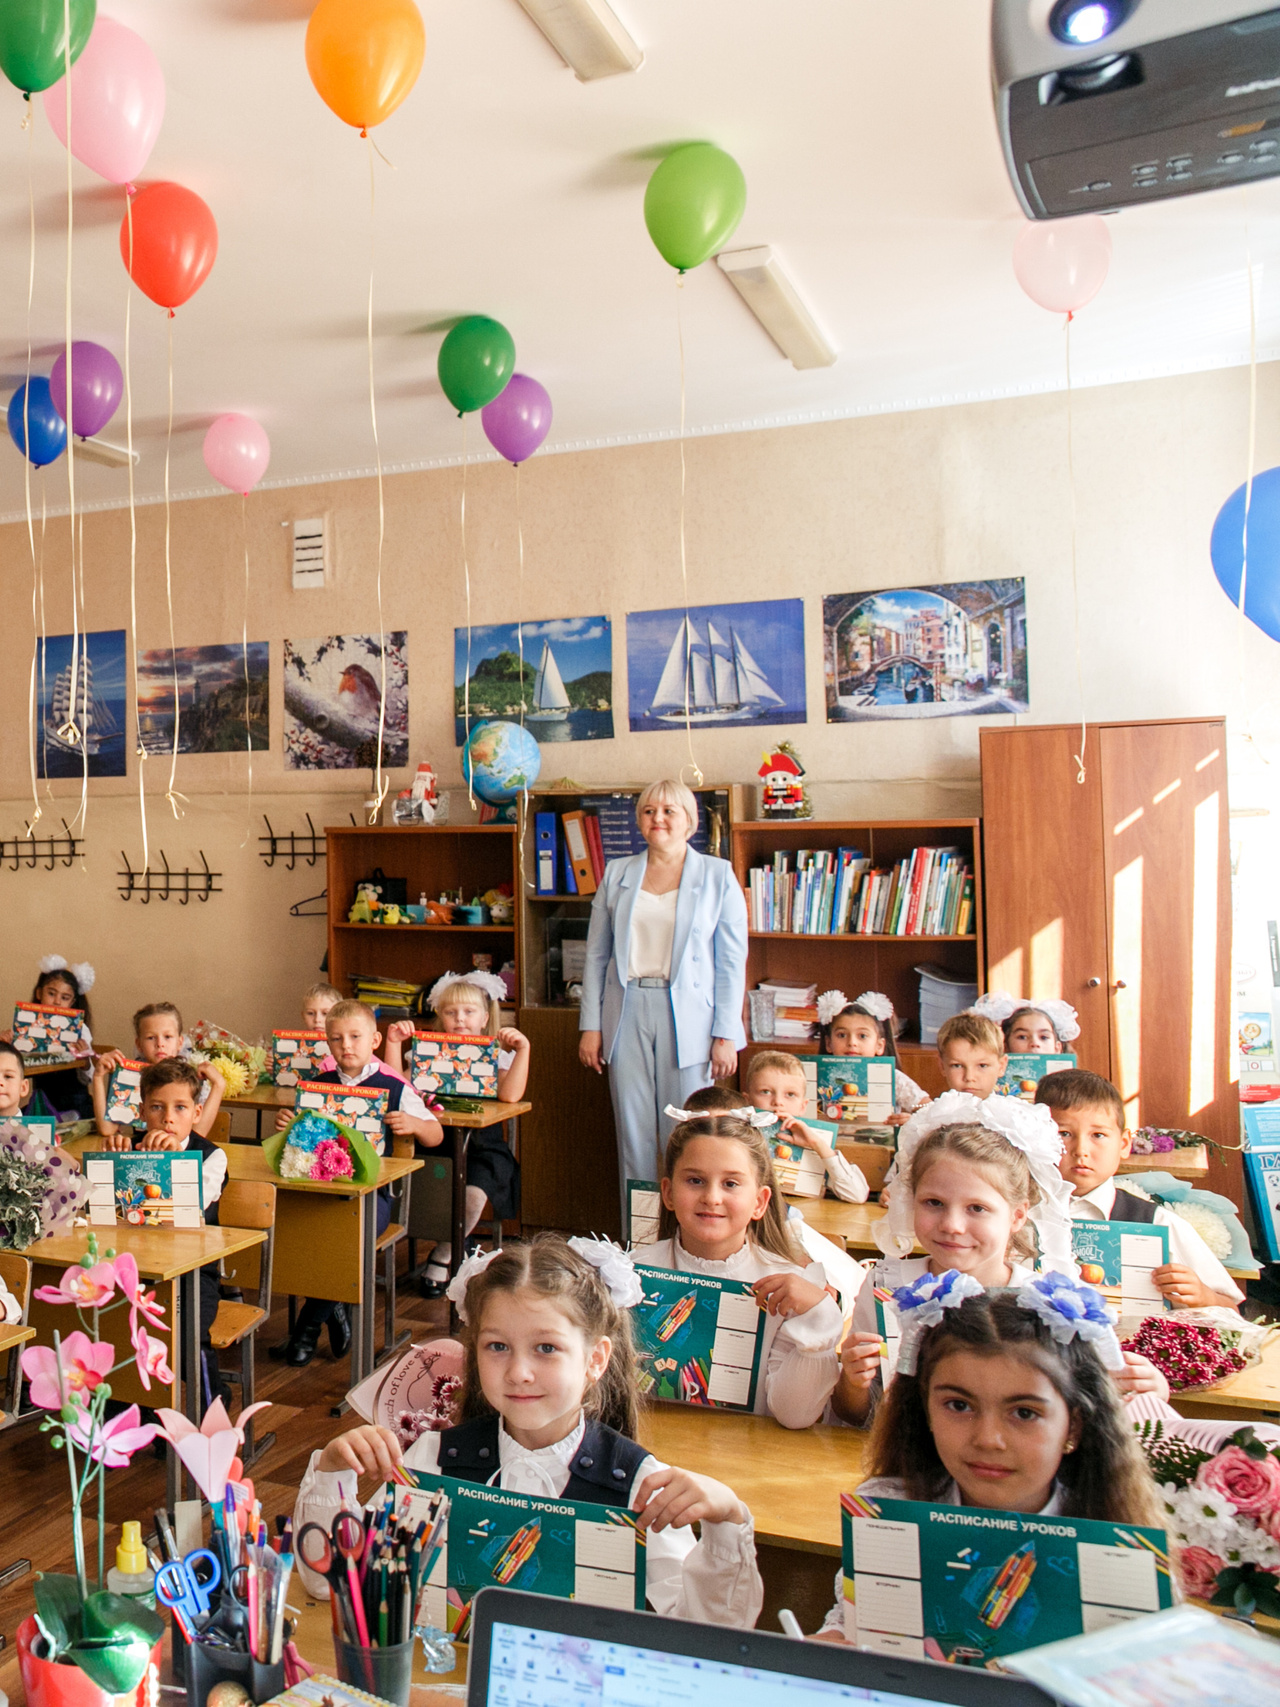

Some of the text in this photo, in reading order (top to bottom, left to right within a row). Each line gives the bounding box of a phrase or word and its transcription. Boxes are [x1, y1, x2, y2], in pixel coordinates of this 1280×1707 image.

[422, 1033, 462, 1041] РАСПИСАНИЕ
[306, 1084, 379, 1096] РАСПИСАНИЕ УРОКОВ
[1085, 1223, 1110, 1231] УРОКОВ
[638, 1269, 722, 1289] РАСПИСАНИЕ УРОКОВ
[385, 1399, 398, 1433] ouch
[398, 1360, 414, 1381] love
[457, 1487, 576, 1516] РАСПИСАНИЕ УРОКОВ
[929, 1511, 1077, 1538] РАСПИСАНИЕ УРОКОВ
